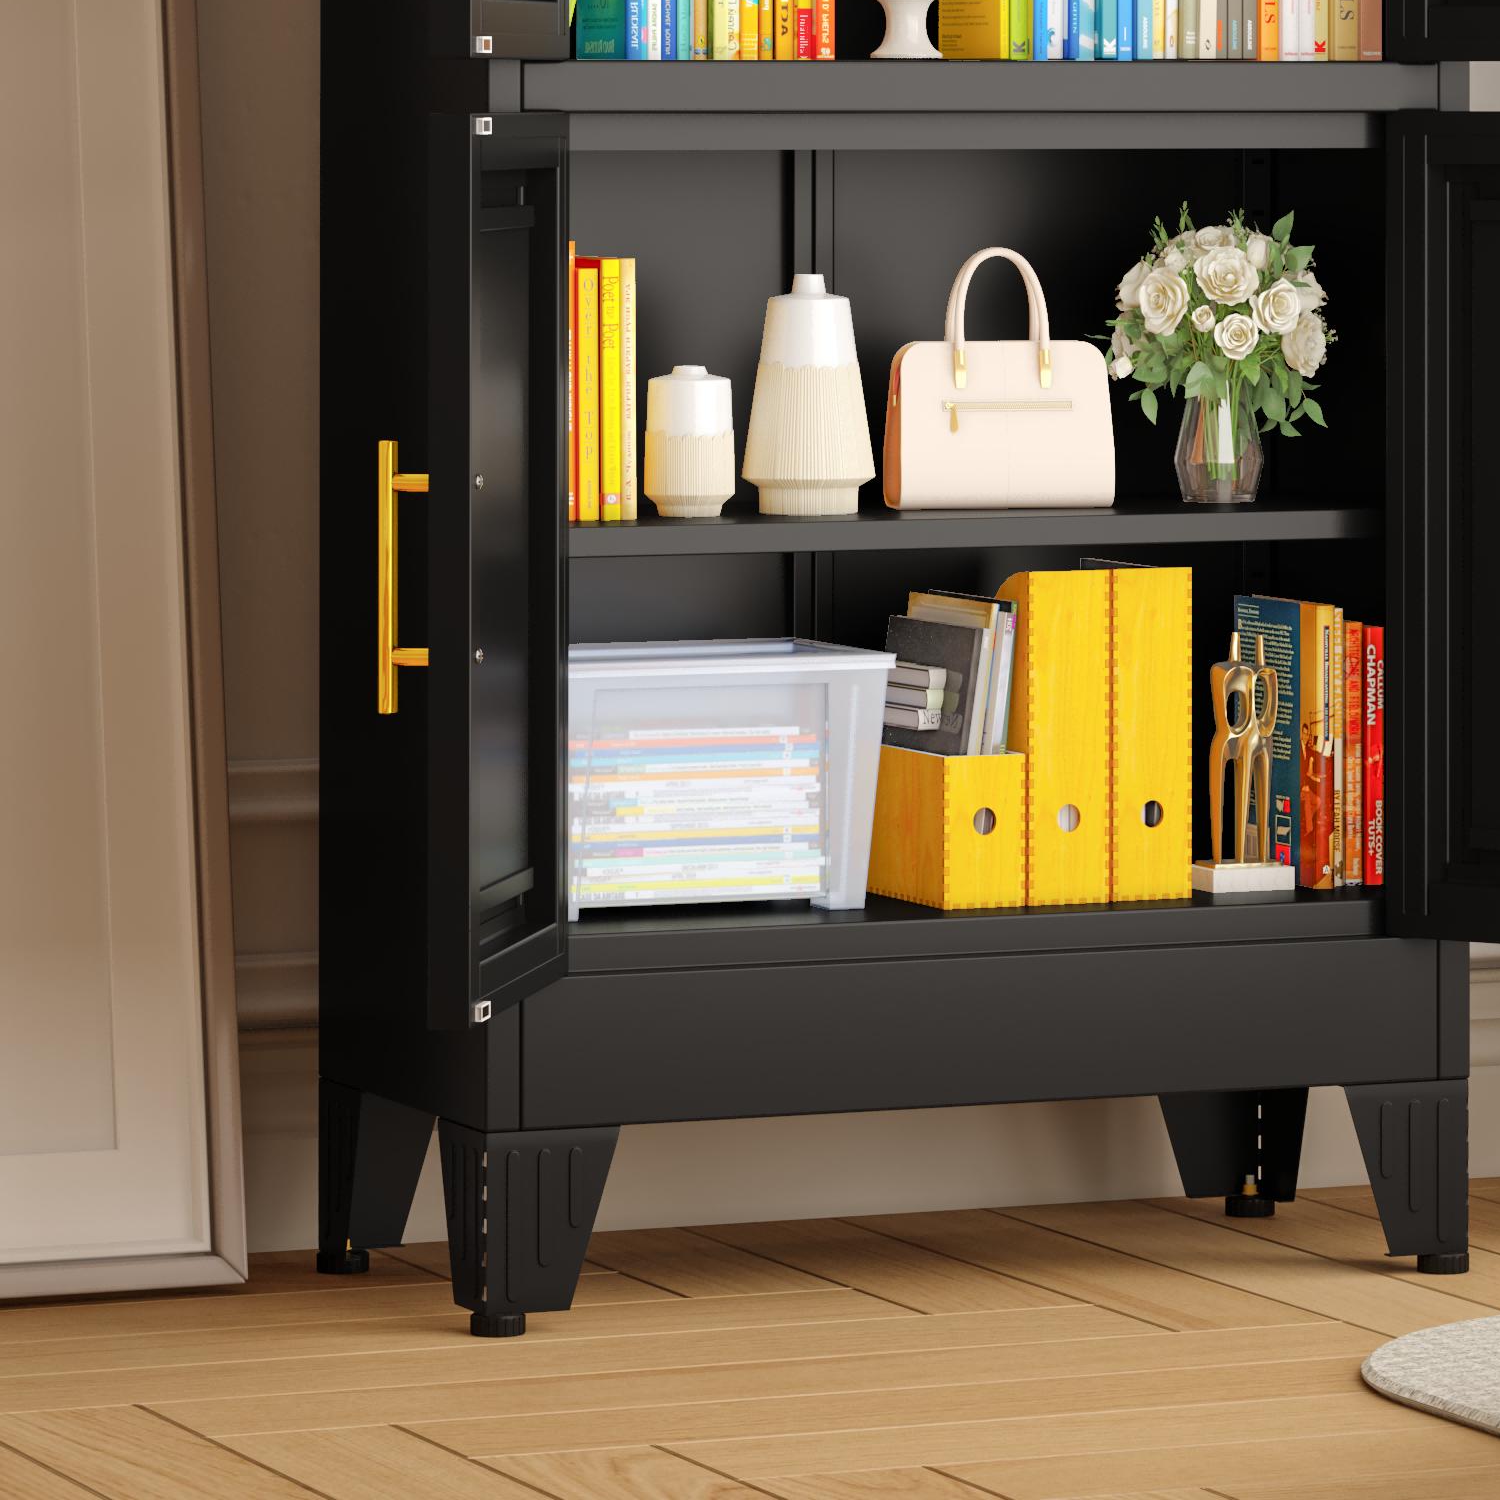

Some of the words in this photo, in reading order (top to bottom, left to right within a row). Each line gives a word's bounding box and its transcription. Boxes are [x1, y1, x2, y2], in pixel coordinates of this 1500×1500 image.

[1366, 644, 1377, 726] CHAPMAN
[1377, 660, 1385, 709] CALLUM
[1375, 800, 1383, 835] BOOK
[1368, 819, 1376, 857] TUTS+
[1375, 836, 1383, 875] COVER
